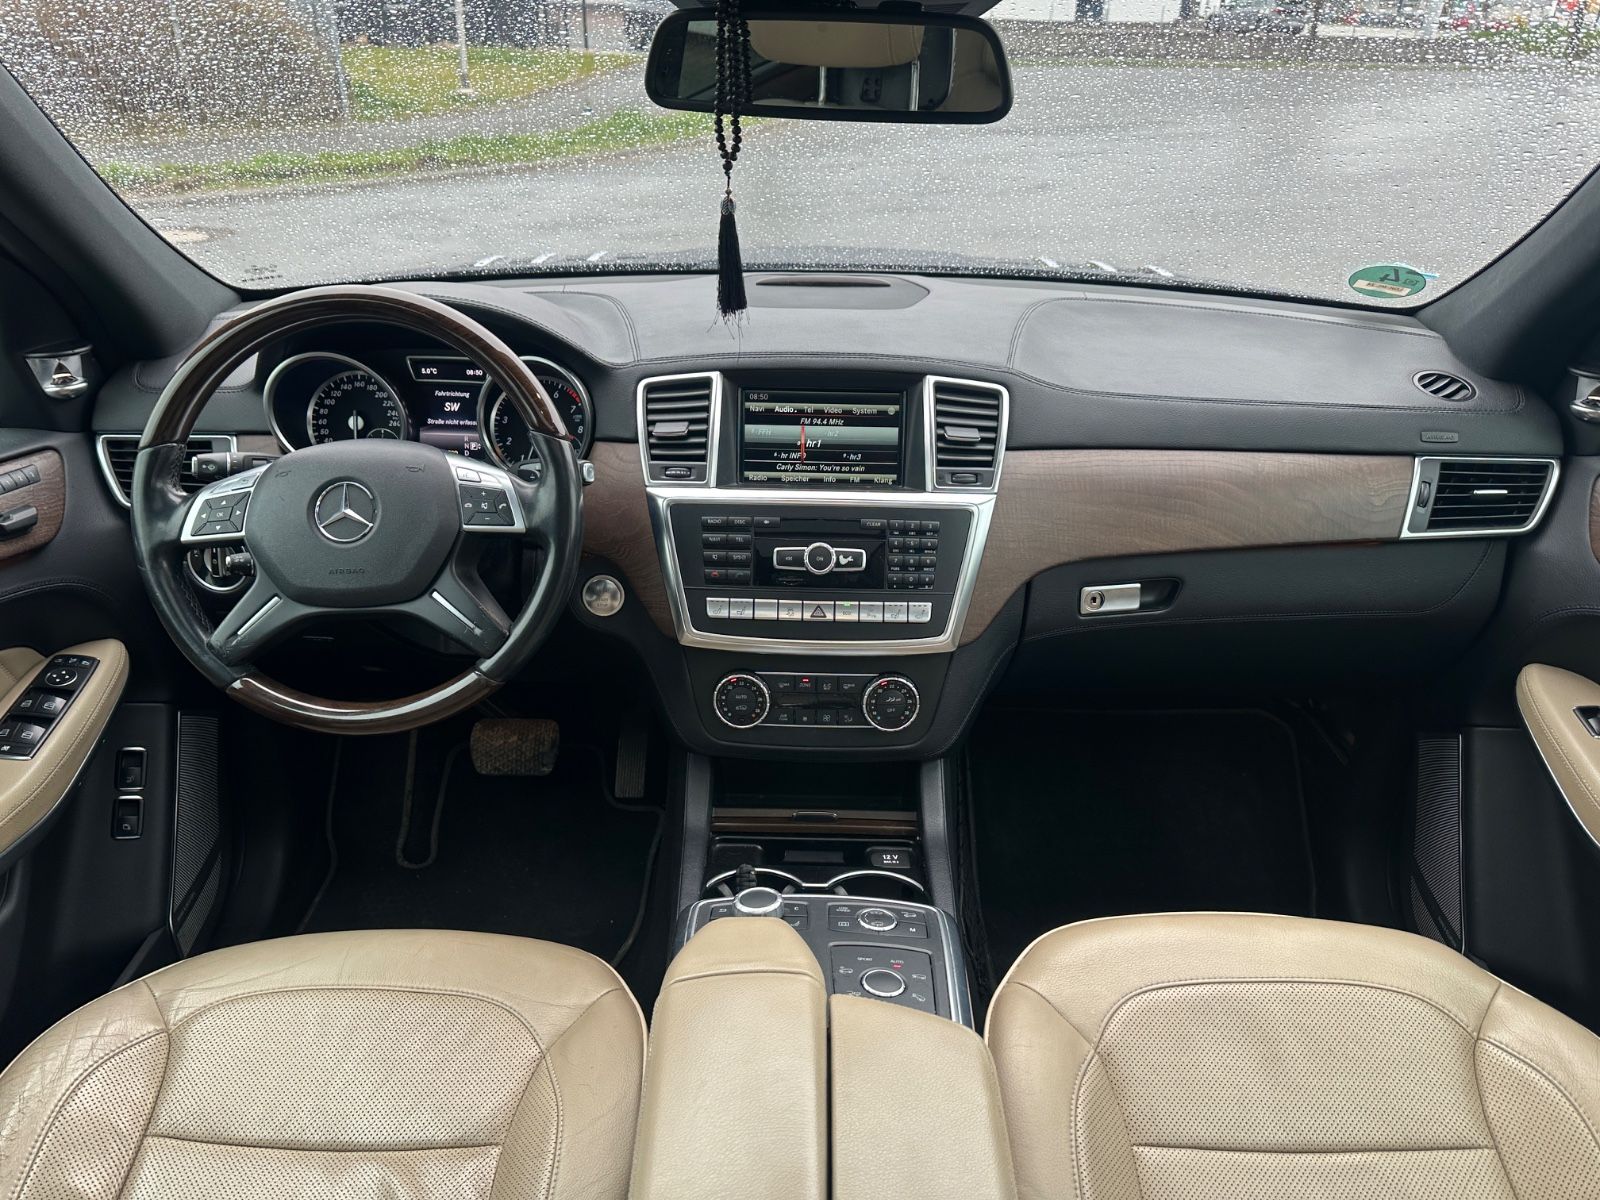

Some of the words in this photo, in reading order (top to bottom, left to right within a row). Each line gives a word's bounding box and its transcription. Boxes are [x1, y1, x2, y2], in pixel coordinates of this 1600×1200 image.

[435, 390, 470, 398] Fahrtrichtung
[444, 402, 460, 412] SW
[570, 405, 576, 413] 7
[852, 408, 878, 416] System
[506, 437, 512, 445] 2
[776, 464, 794, 472] Carly
[781, 475, 809, 483] Speicher
[874, 476, 893, 485] Klang
